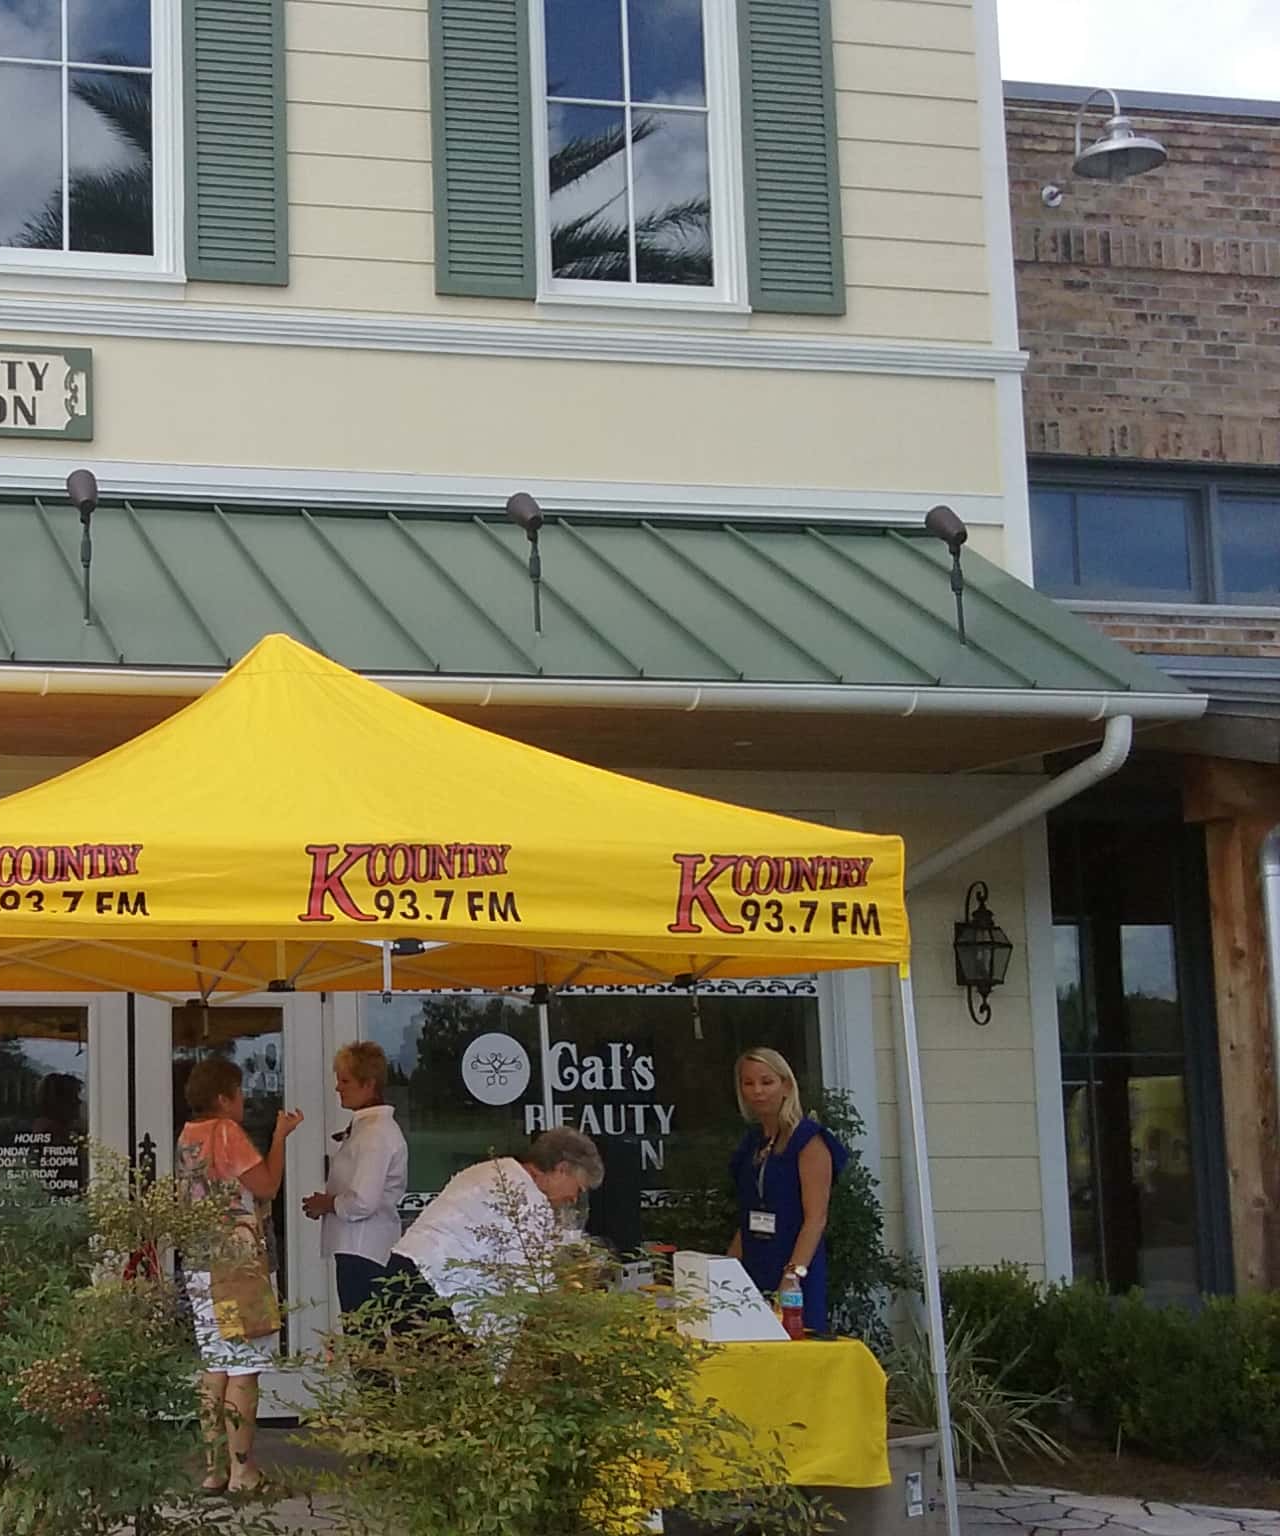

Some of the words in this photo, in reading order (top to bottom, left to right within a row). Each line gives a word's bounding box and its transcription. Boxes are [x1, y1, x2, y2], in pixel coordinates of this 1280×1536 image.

[0, 889, 84, 914] 93.7
[95, 891, 150, 916] FM
[373, 888, 455, 921] 93.7
[466, 890, 523, 922] FM
[739, 898, 819, 933] 93.7
[831, 901, 882, 936] FM
[524, 1103, 676, 1136] BEAUTY
[14, 1133, 52, 1143] HOURS
[43, 1146, 79, 1156] FRIDAY
[40, 1157, 79, 1167] 5:00PM
